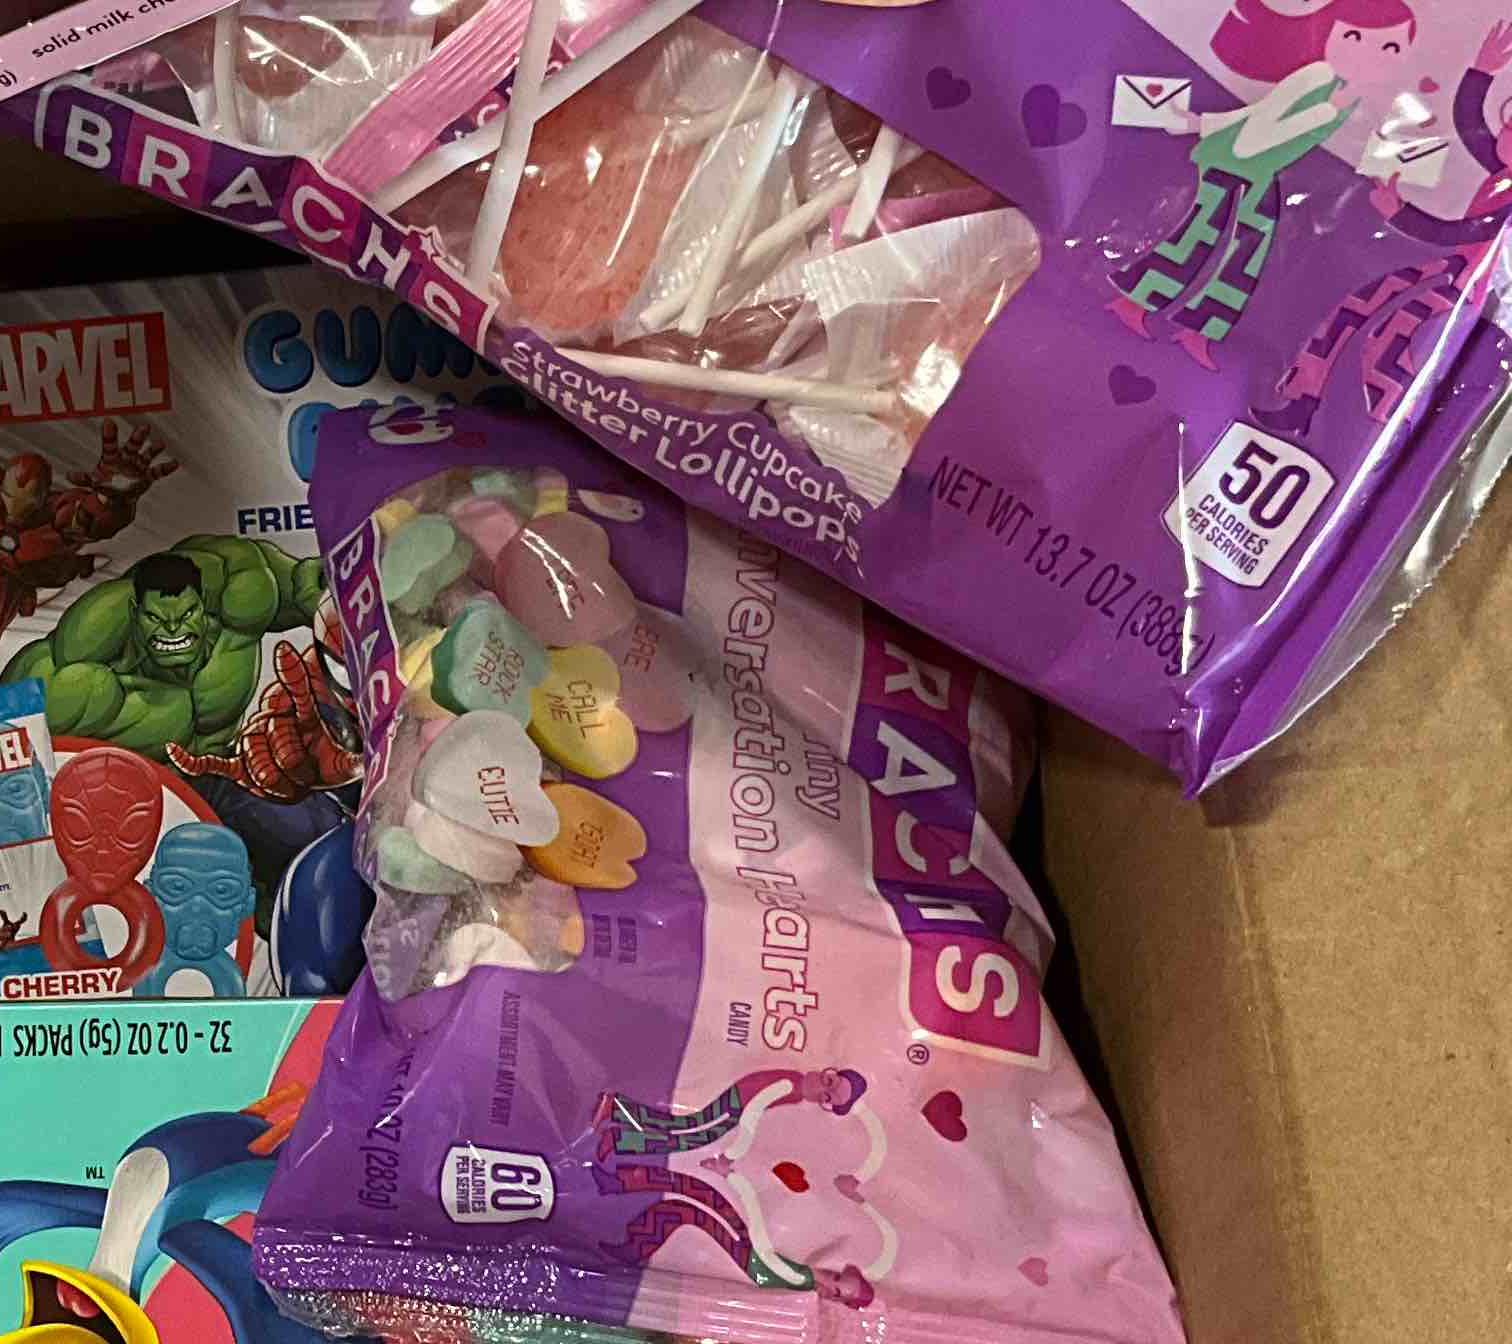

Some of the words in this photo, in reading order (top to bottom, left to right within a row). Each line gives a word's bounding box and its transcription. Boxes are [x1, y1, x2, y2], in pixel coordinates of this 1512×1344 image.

[29, 20, 84, 58] solid
[85, 3, 137, 45] milk
[499, 356, 649, 444] Glitter
[655, 434, 865, 563] Lollipops
[510, 340, 719, 447] Strawberry
[727, 421, 864, 526] Cupcake
[1218, 439, 1311, 530] 50
[928, 455, 993, 518] NET
[987, 487, 1035, 547] WT
[1024, 525, 1097, 591] 13.7
[1086, 562, 1138, 620] OZ
[1197, 493, 1270, 556] CALORIES
[1205, 525, 1260, 576] SERVING
[568, 678, 598, 740] CALL
[476, 765, 521, 825] CUTIE
[2, 970, 118, 999] CHERRY
[12, 1022, 73, 1057] PACKS
[78, 1017, 122, 1057] (5g)
[126, 1022, 155, 1055] OZ
[156, 1021, 190, 1055] 0.2
[208, 1020, 233, 1055] 32
[724, 1001, 753, 1048] CANDY
[357, 1144, 401, 1211] (283g)
[490, 1162, 543, 1211] 60
